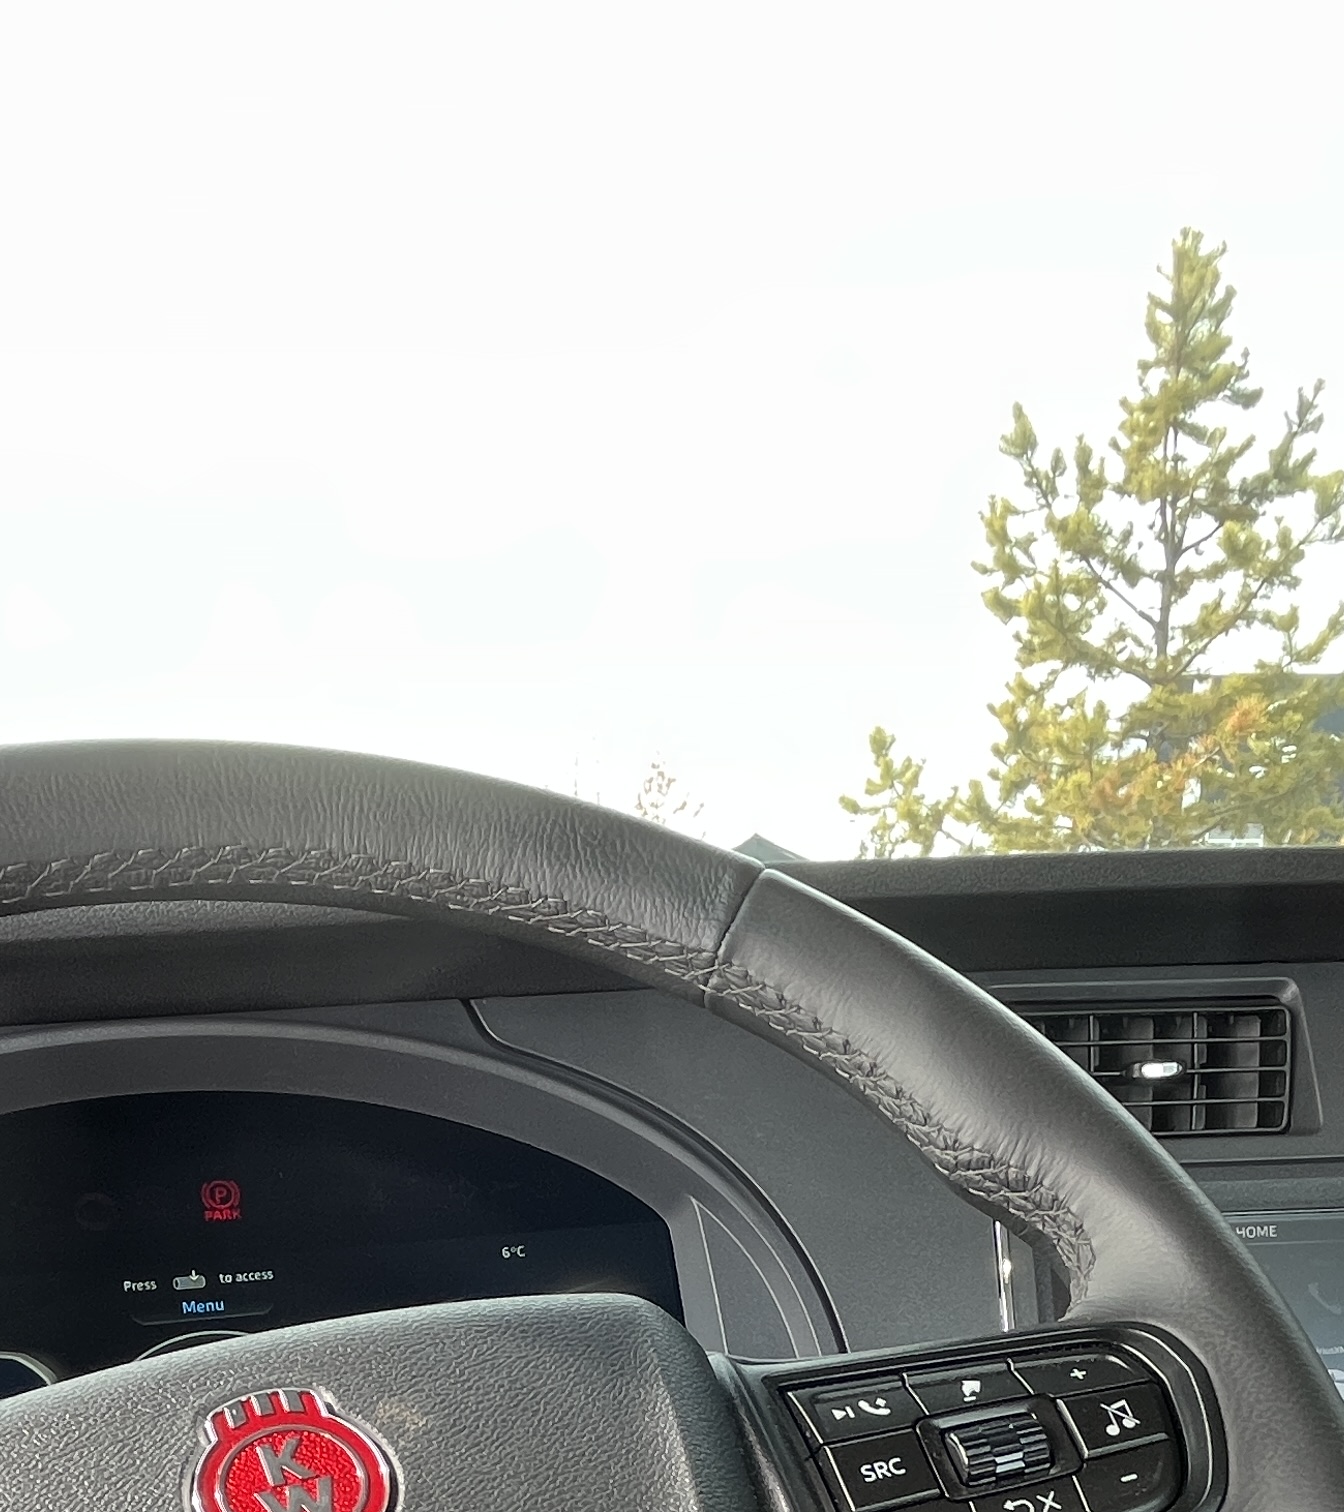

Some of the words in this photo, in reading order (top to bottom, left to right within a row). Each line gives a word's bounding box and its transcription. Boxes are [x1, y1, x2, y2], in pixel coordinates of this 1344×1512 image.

[204, 1208, 242, 1222] PARK
[502, 1245, 526, 1259] 6°C
[123, 1279, 157, 1293] Press
[219, 1272, 232, 1283] to
[235, 1269, 274, 1282] access
[182, 1299, 225, 1314] Menu
[860, 1457, 906, 1484] SRC
